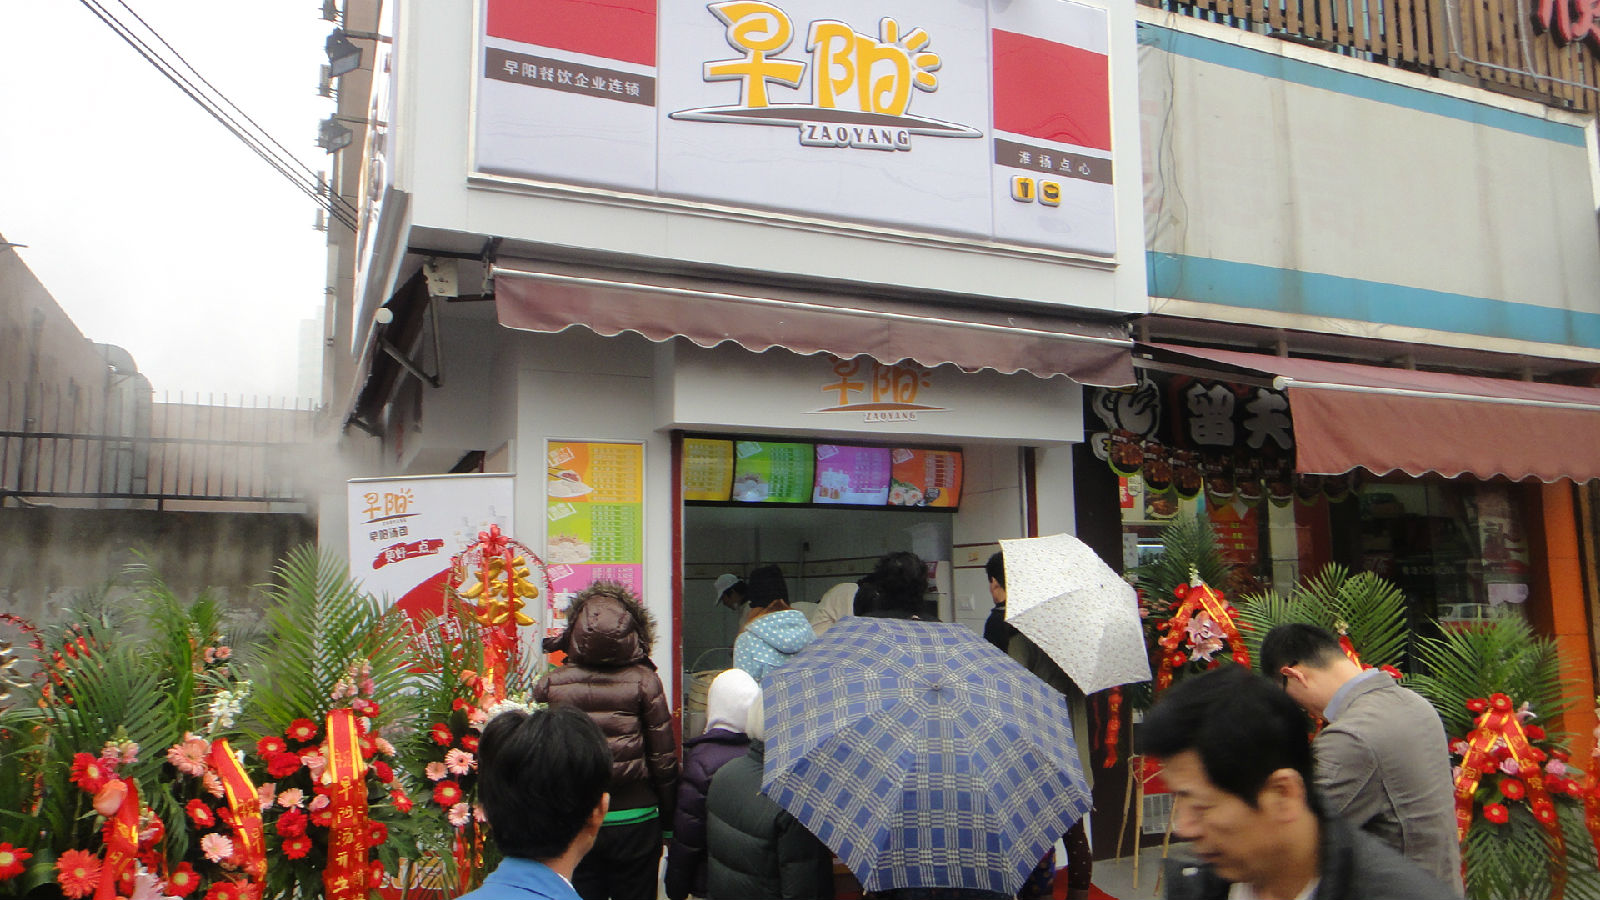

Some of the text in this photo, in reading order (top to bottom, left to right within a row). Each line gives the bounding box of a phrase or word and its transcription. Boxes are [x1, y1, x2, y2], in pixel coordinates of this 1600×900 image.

[704, 1, 941, 116] 早阳
[503, 59, 641, 97] 早阳餐饮企业连锁
[806, 124, 909, 145] ZAOYANG
[1019, 150, 1091, 176] 淮扬点心
[865, 411, 917, 422] ZAOYANG
[1186, 382, 1293, 449] 留夫
[362, 488, 414, 519] 早阳
